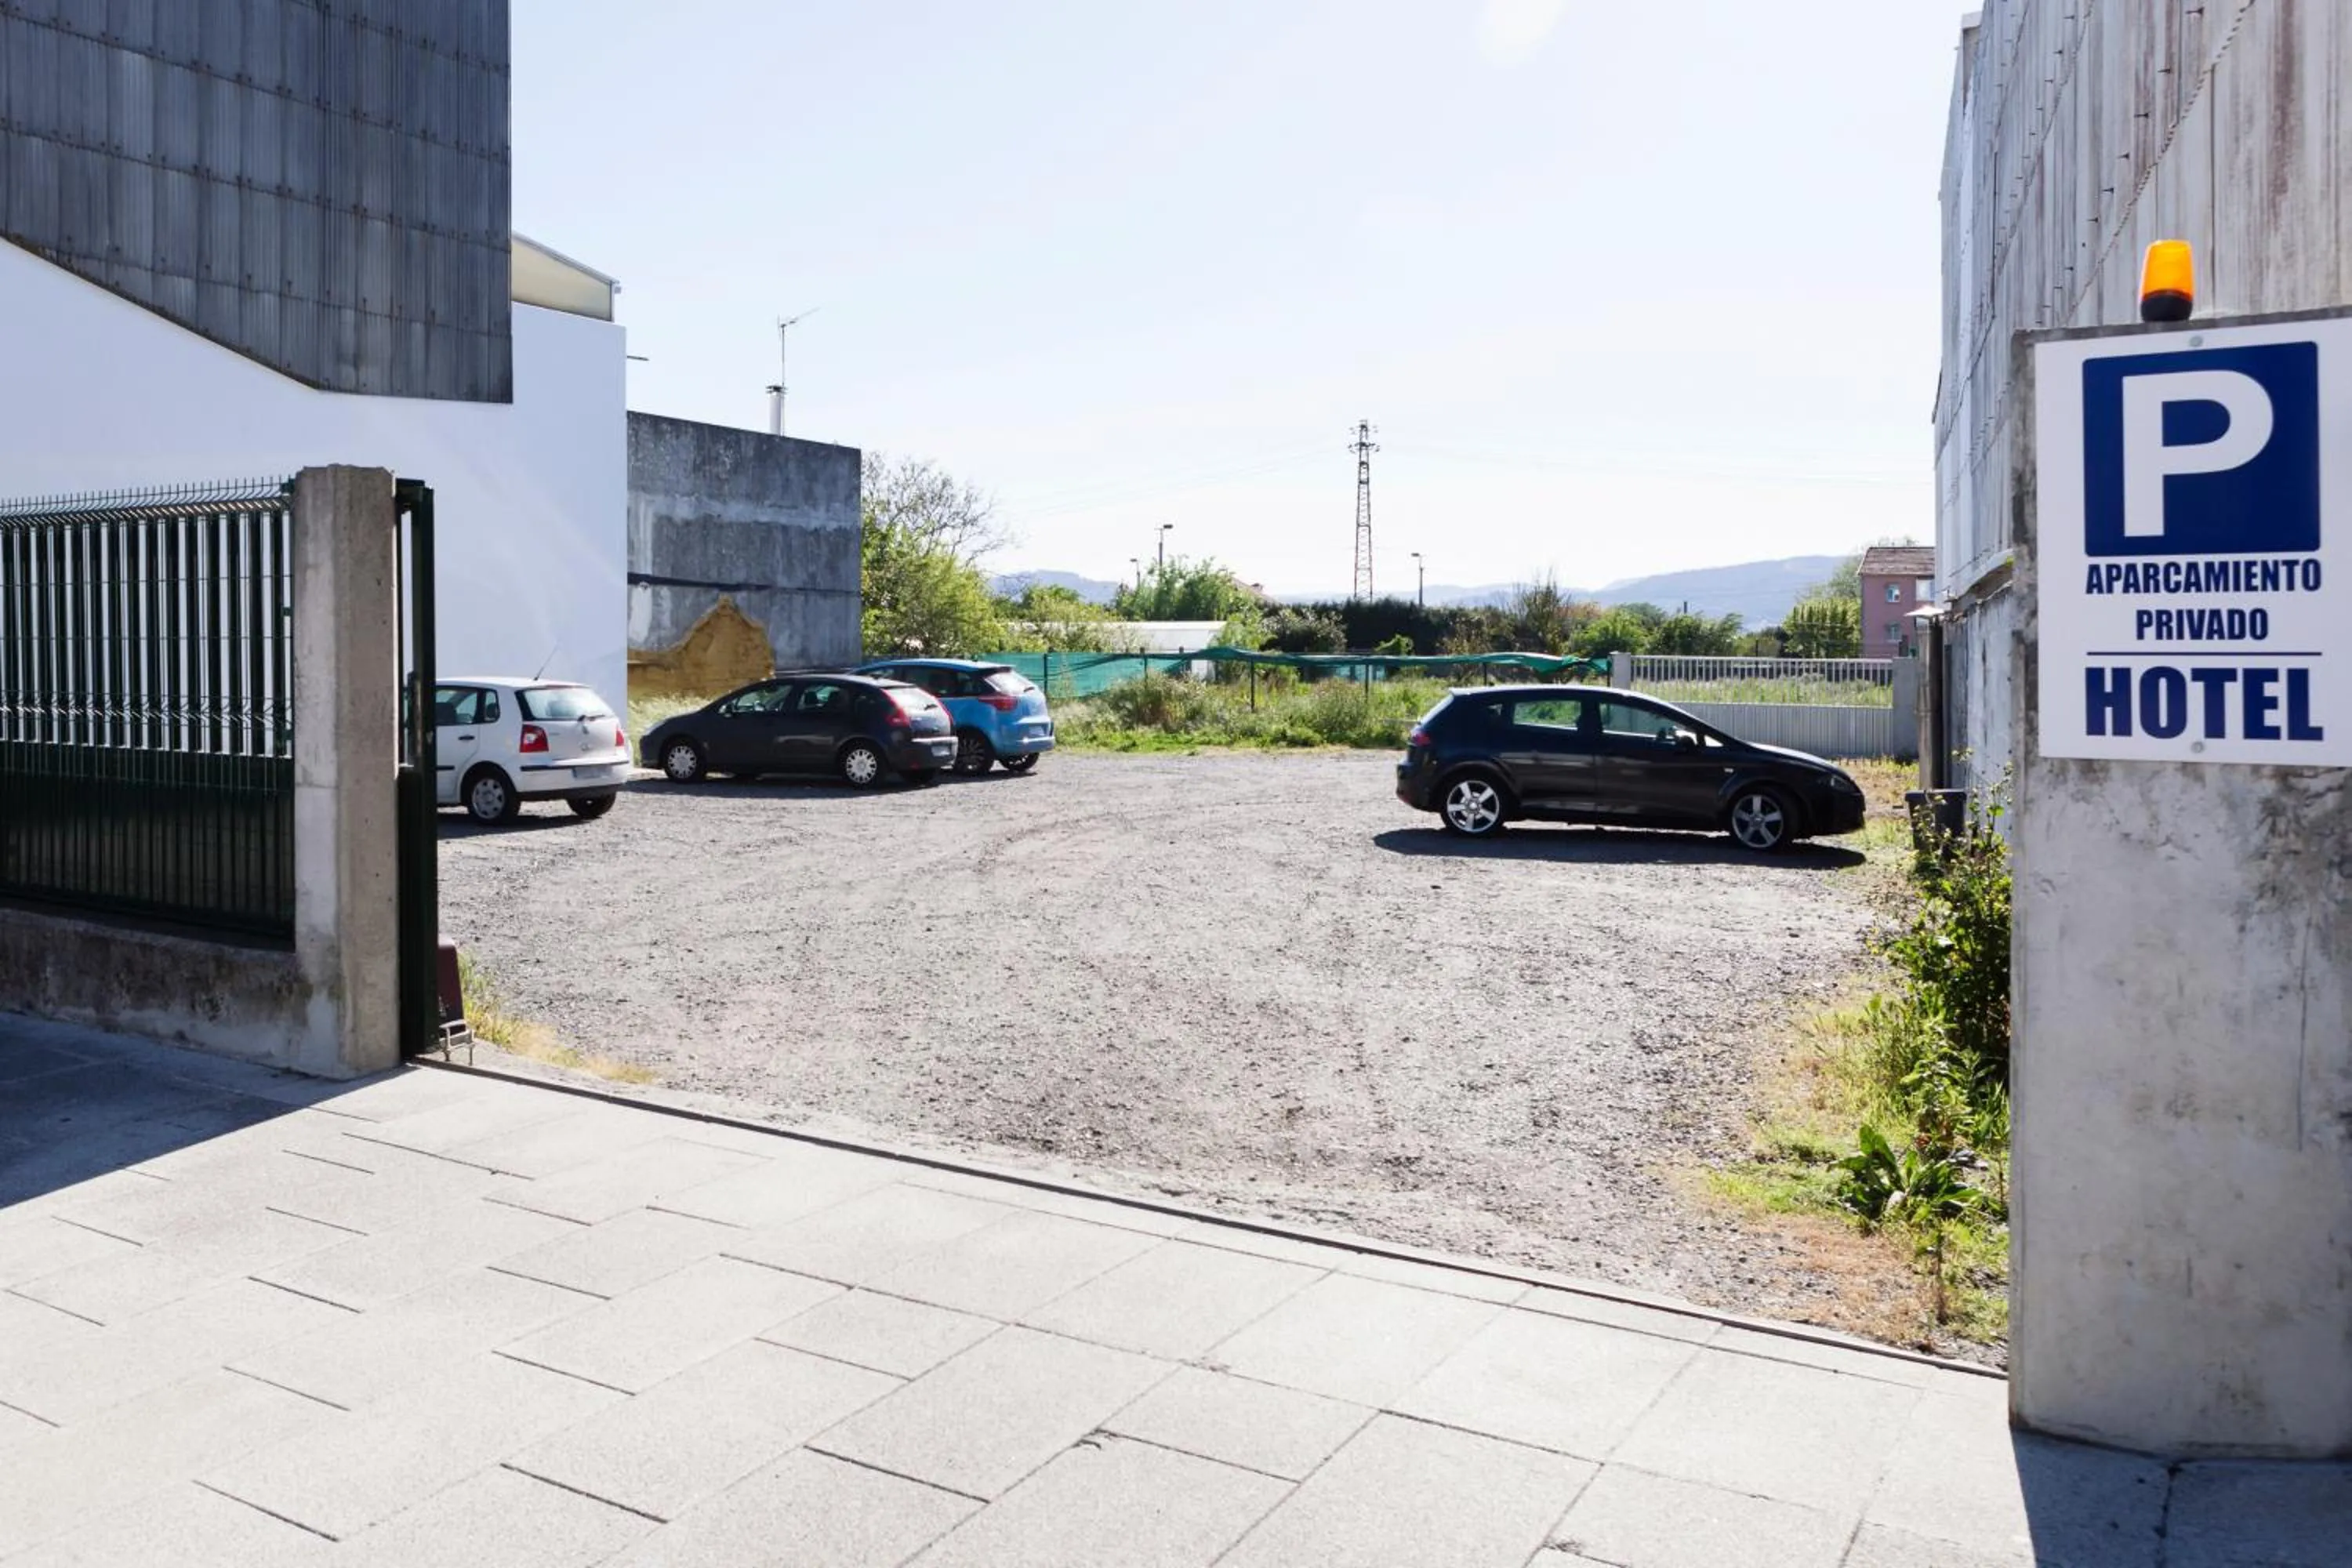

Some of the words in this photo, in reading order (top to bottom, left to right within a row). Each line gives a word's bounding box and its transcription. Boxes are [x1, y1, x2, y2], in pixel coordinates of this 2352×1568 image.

[2122, 369, 2274, 537] P
[2085, 558, 2322, 594] APARCAMIENTO
[2136, 608, 2269, 641] PRIVADO
[2085, 665, 2324, 742] HOTEL
